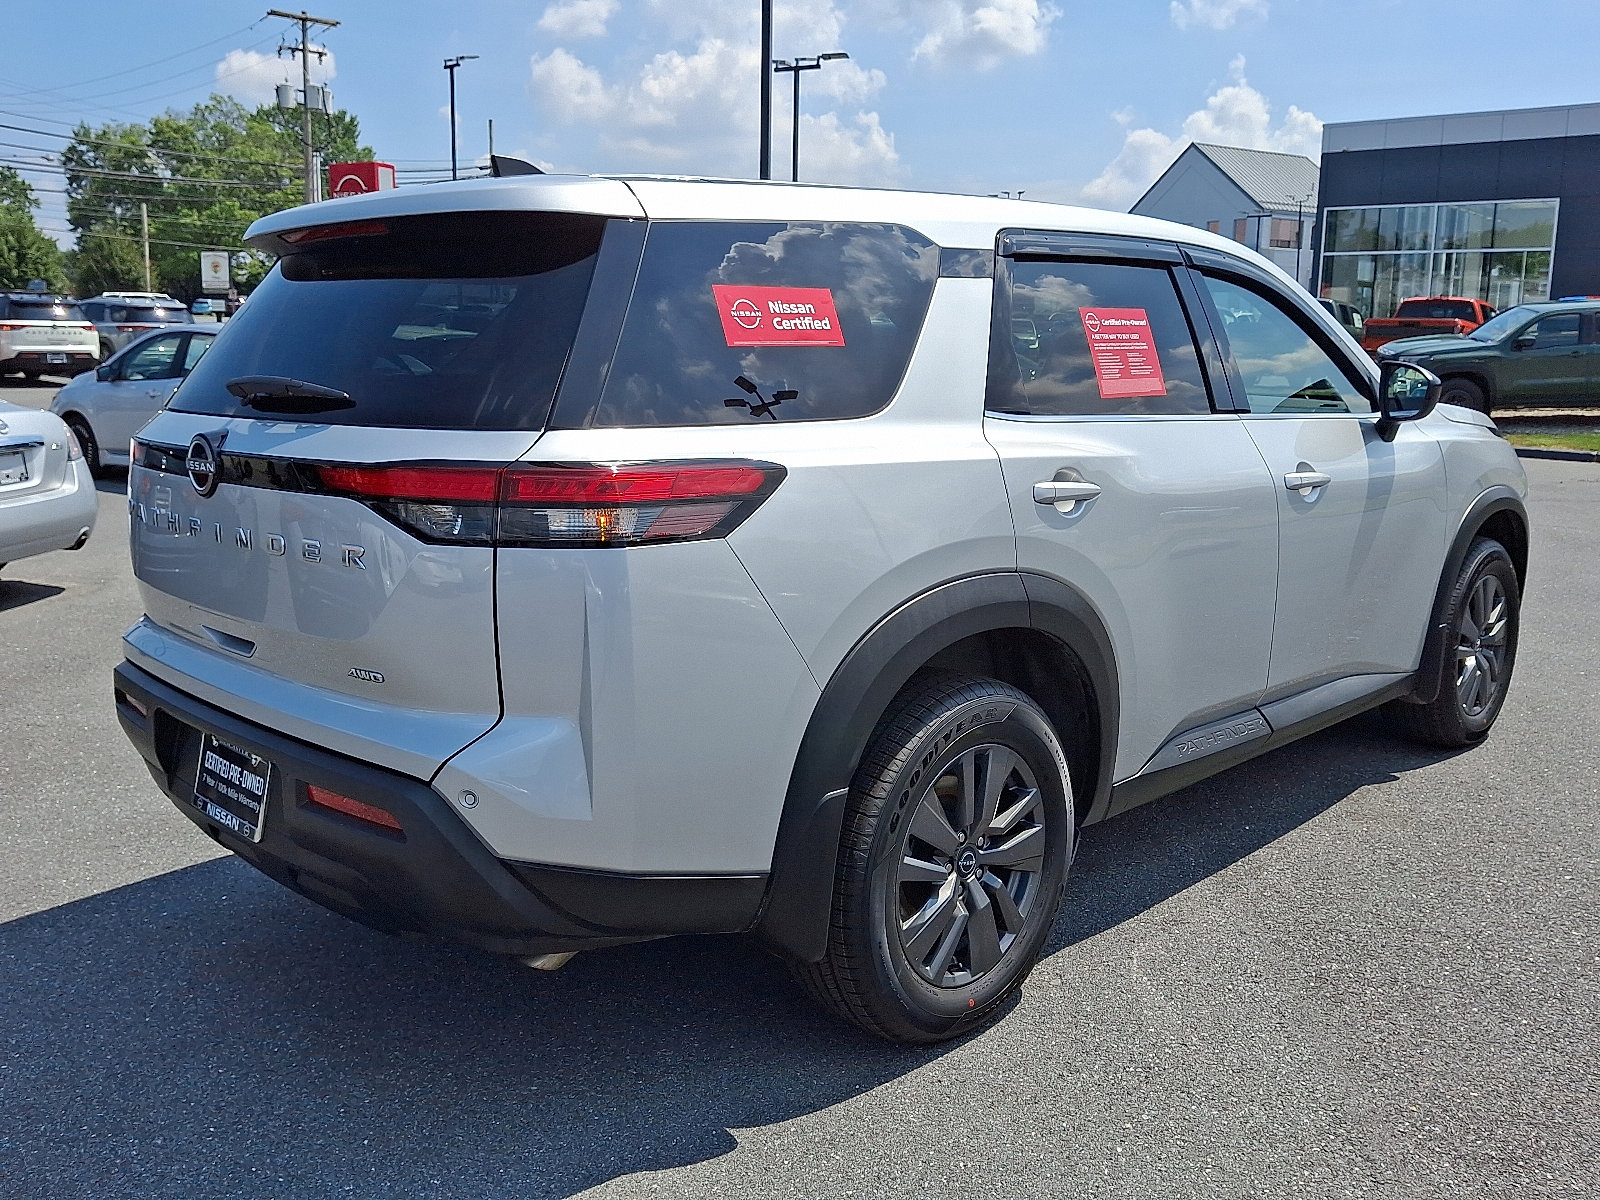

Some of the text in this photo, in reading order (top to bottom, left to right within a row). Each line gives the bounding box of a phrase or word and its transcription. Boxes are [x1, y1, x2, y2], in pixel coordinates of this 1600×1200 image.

[767, 300, 816, 314] Nissan
[772, 316, 832, 331] Certified
[1101, 318, 1121, 326] Certified
[1175, 717, 1266, 758] PATHFINDER
[204, 750, 230, 779] CERTIFIED
[229, 763, 265, 796] PRE-OWNED
[227, 787, 239, 801] Mile
[238, 792, 261, 814] Warranty
[206, 803, 240, 831] NISSAN
